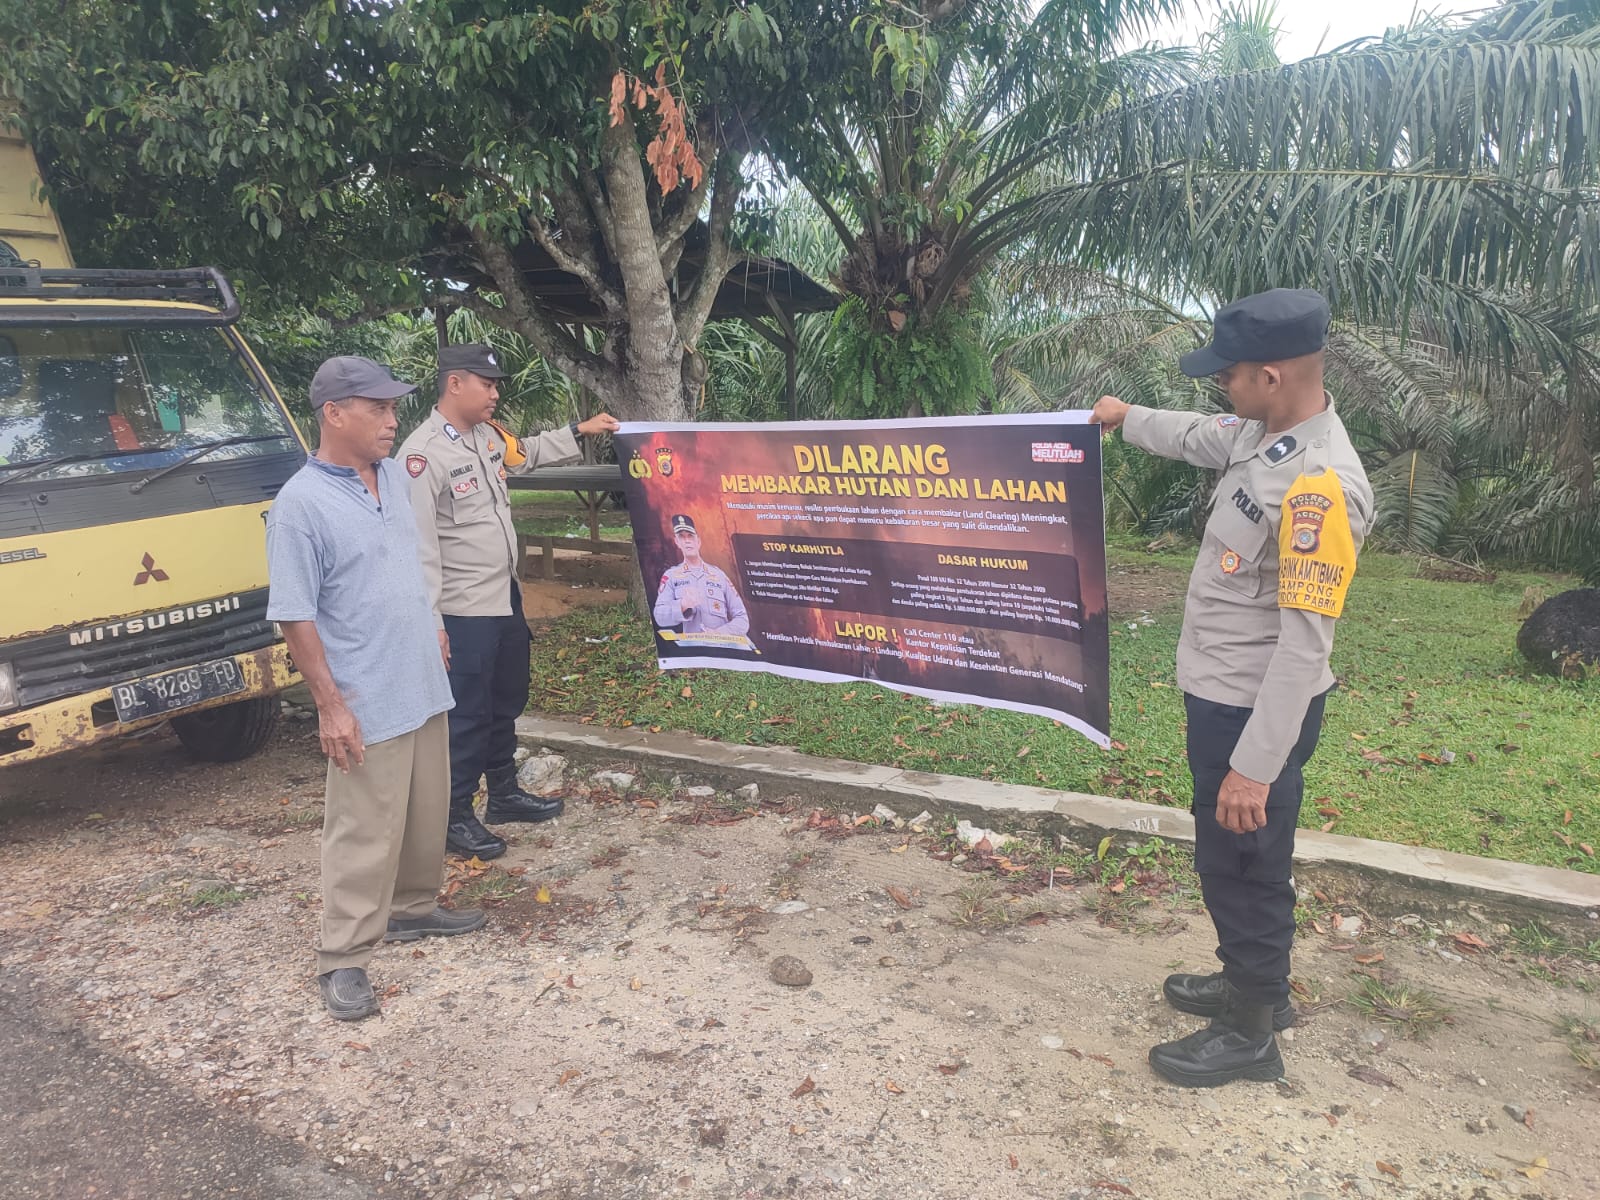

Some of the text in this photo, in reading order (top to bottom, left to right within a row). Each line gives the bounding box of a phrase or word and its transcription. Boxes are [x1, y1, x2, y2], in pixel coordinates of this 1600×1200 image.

[793, 444, 949, 476] DILARANG
[720, 474, 1067, 503] MEMBAKAR HUTAN DAN LAHAN
[1232, 486, 1264, 524] POLRI
[1291, 494, 1330, 507] POLRES
[838, 516, 856, 524] dapat
[922, 519, 940, 527] besar
[942, 521, 960, 530] yang
[962, 521, 976, 530] sulit
[860, 506, 879, 514] lahan
[880, 506, 906, 517] dengan
[924, 508, 961, 518] membakar
[986, 511, 1019, 523] Clearing)
[1022, 514, 1068, 525] Meningkat,
[1296, 511, 1322, 520] ACEH
[762, 542, 844, 556] STOP KARHUTLA
[937, 554, 1029, 571] DASAR HUKUM
[1304, 594, 1337, 611] PABRIK
[70, 597, 240, 646] MITSUBISHI
[834, 620, 889, 642] LAPOR
[918, 630, 942, 640] Center
[943, 632, 956, 642] 110
[958, 636, 974, 645] atau
[906, 638, 1000, 658] Kantor Kepolisian Terdekat
[876, 646, 904, 658] Lindungi
[904, 650, 932, 662] Kualitas
[933, 654, 954, 666] Udara
[954, 660, 968, 668] dan
[969, 660, 1008, 674] Kesehatan
[1009, 666, 1043, 679] Generasi
[117, 684, 146, 710] BL
[154, 670, 202, 699] 8289
